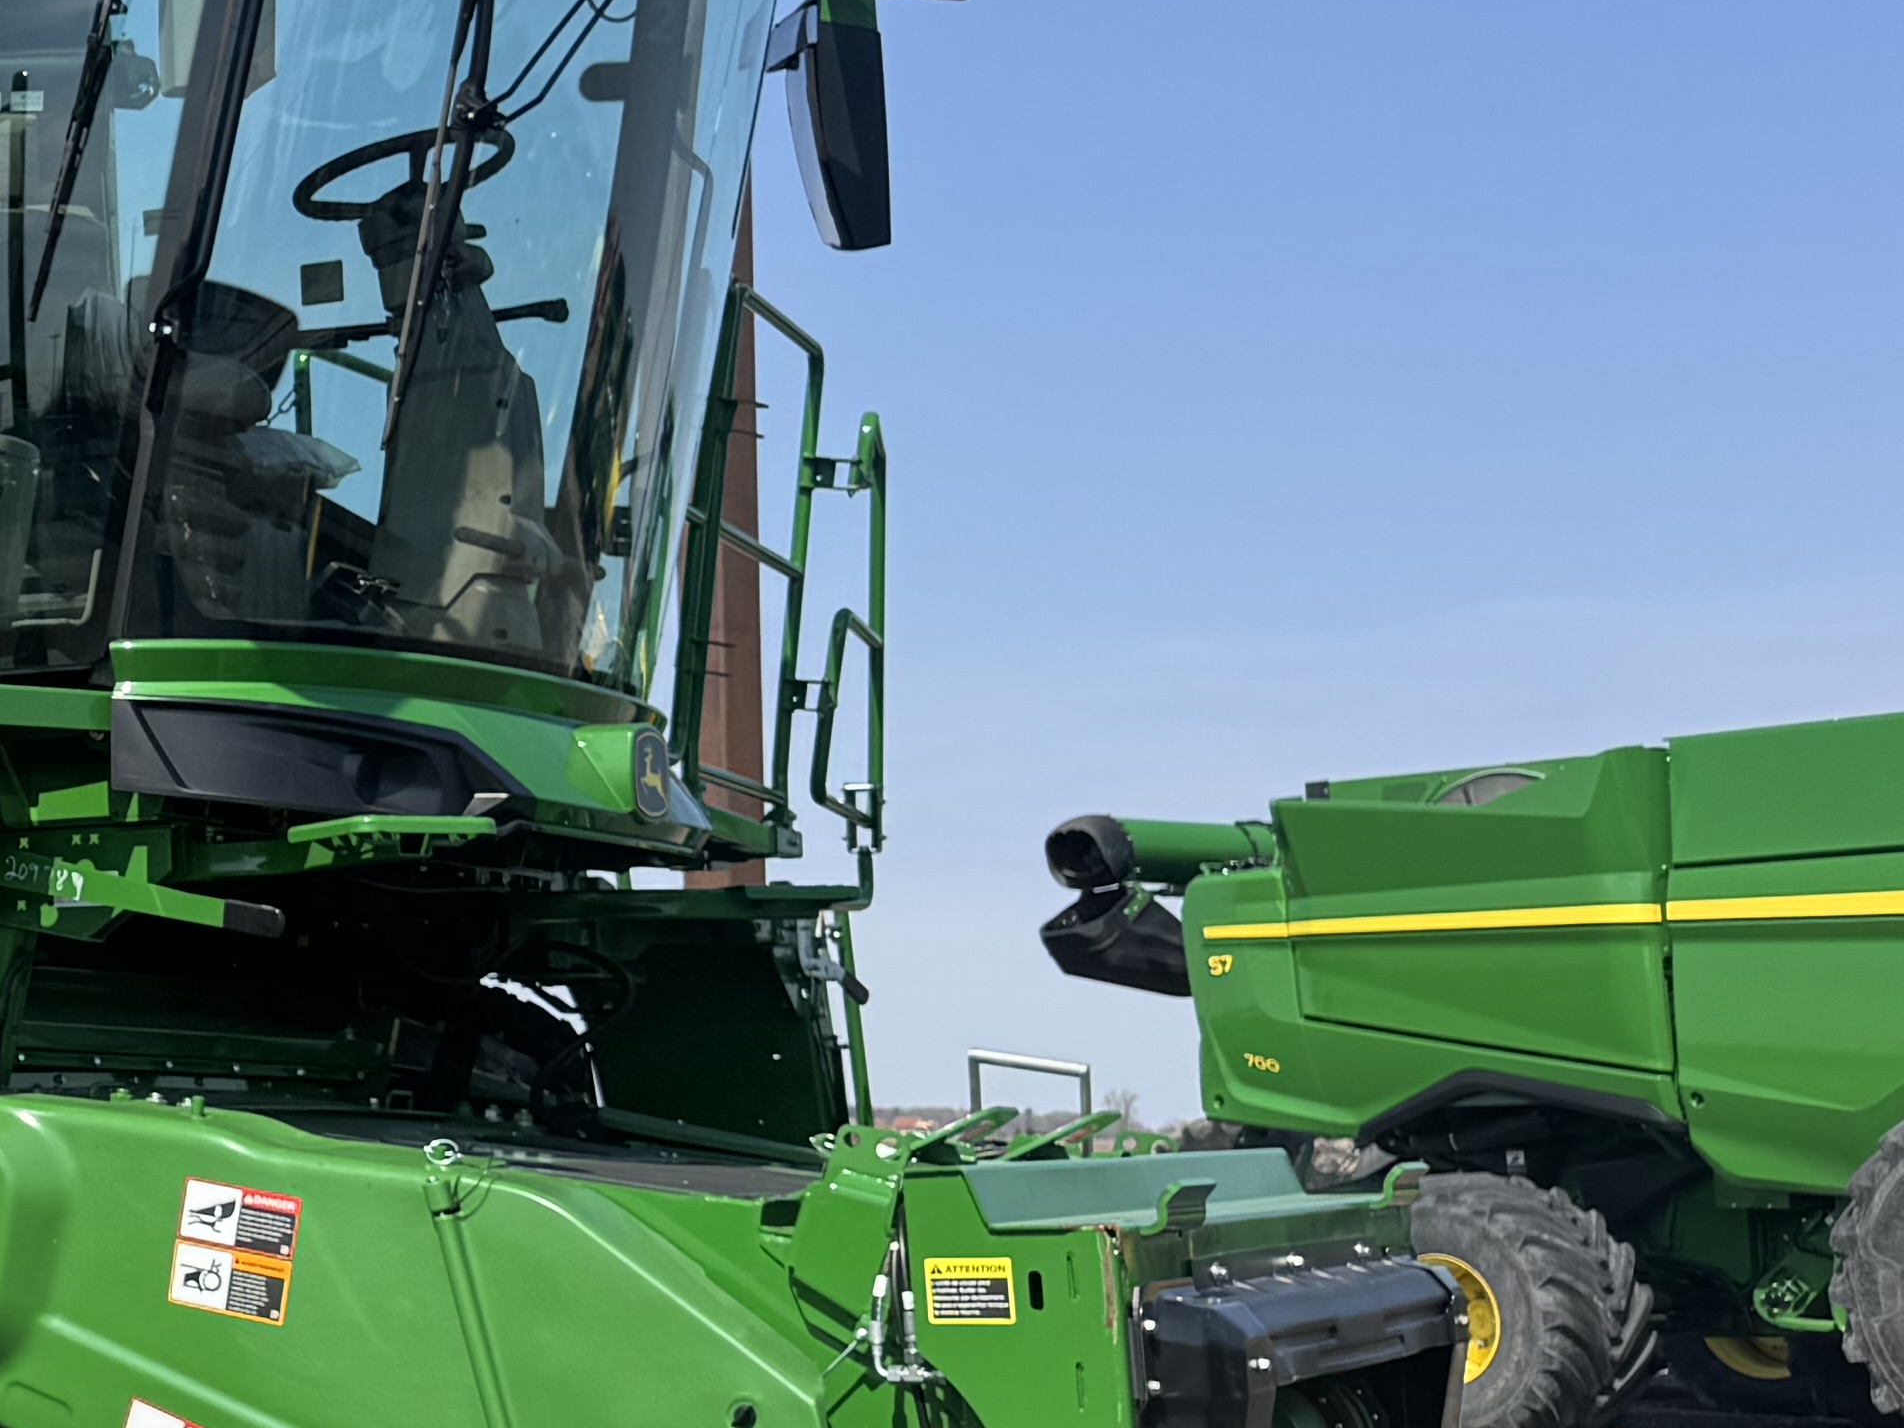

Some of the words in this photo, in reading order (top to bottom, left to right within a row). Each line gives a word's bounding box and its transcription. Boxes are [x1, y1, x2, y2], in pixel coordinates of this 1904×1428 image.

[1207, 954, 1233, 976] S7
[253, 1194, 297, 1211] DANGER
[945, 1265, 1006, 1273] ATTENTION
